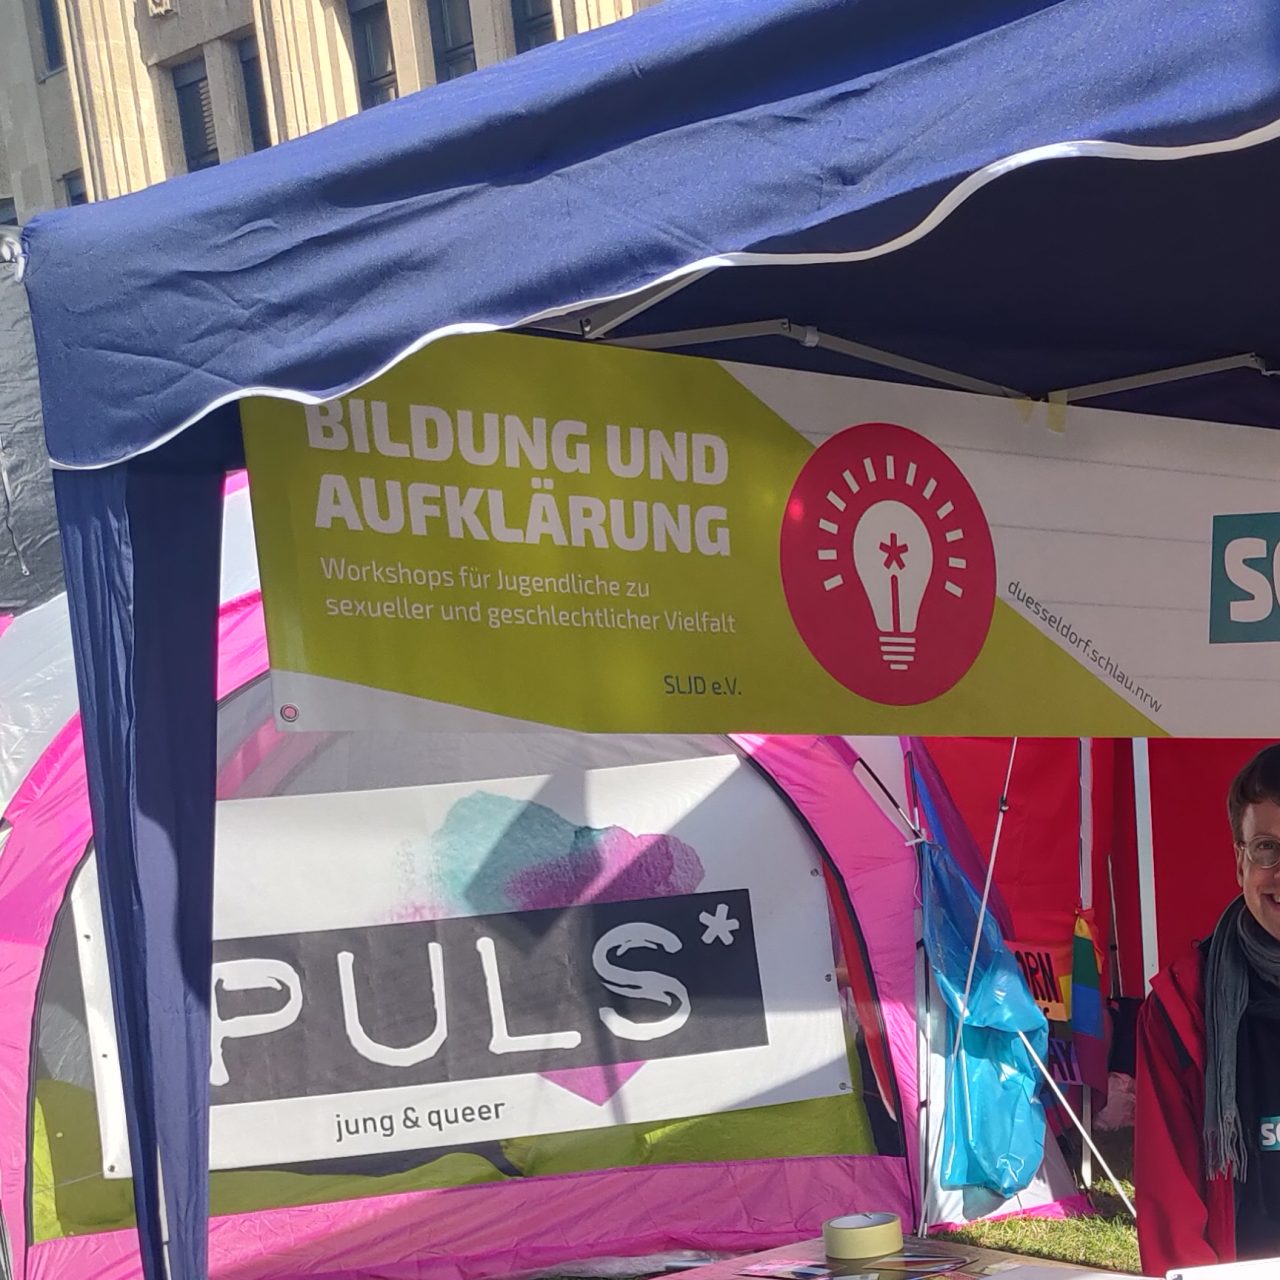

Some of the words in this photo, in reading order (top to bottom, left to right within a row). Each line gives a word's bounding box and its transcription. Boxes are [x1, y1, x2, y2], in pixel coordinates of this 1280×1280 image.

[305, 399, 592, 474] BILDUNG
[605, 424, 729, 486] UND
[315, 474, 731, 556] AUFKLÄRUNG
[320, 557, 454, 590] Workshops
[459, 566, 490, 589] für
[497, 569, 620, 598] Jugendliche
[626, 581, 650, 598] zu
[326, 597, 434, 620] sexueller
[441, 602, 481, 621] und
[488, 605, 660, 631] geschlechtlicher
[664, 611, 736, 633] Vielfalt
[1006, 578, 1162, 714] duesseldorf.schlau.nrw
[712, 676, 742, 696] e.V.
[335, 1114, 395, 1144] jung
[402, 1110, 422, 1130] &
[428, 1099, 506, 1132] queer
